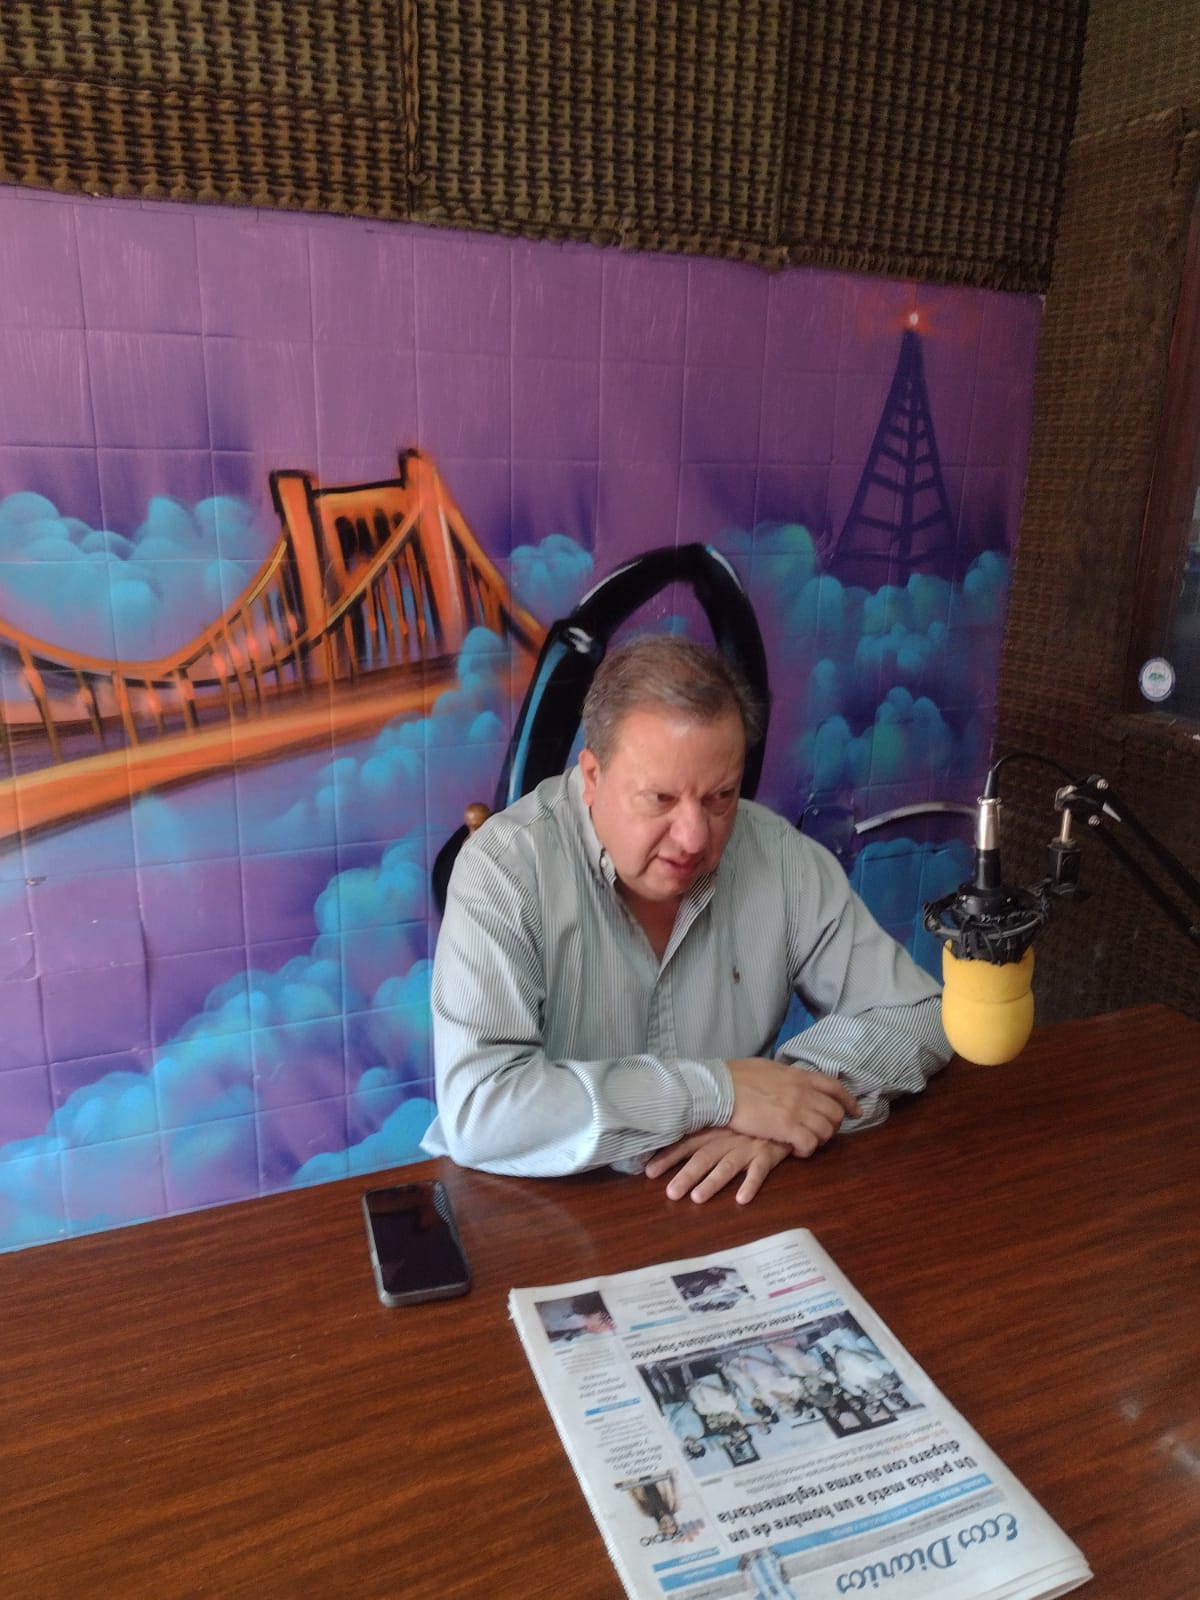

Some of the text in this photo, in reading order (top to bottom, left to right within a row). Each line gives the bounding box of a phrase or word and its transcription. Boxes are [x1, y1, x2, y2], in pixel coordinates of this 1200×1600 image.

[717, 1439, 960, 1523] disparo con su arma reglamentaria
[727, 1455, 978, 1543] Un policía mató a un hombre de un
[836, 1536, 955, 1593] Diarios
[957, 1512, 1018, 1549] Ecos
